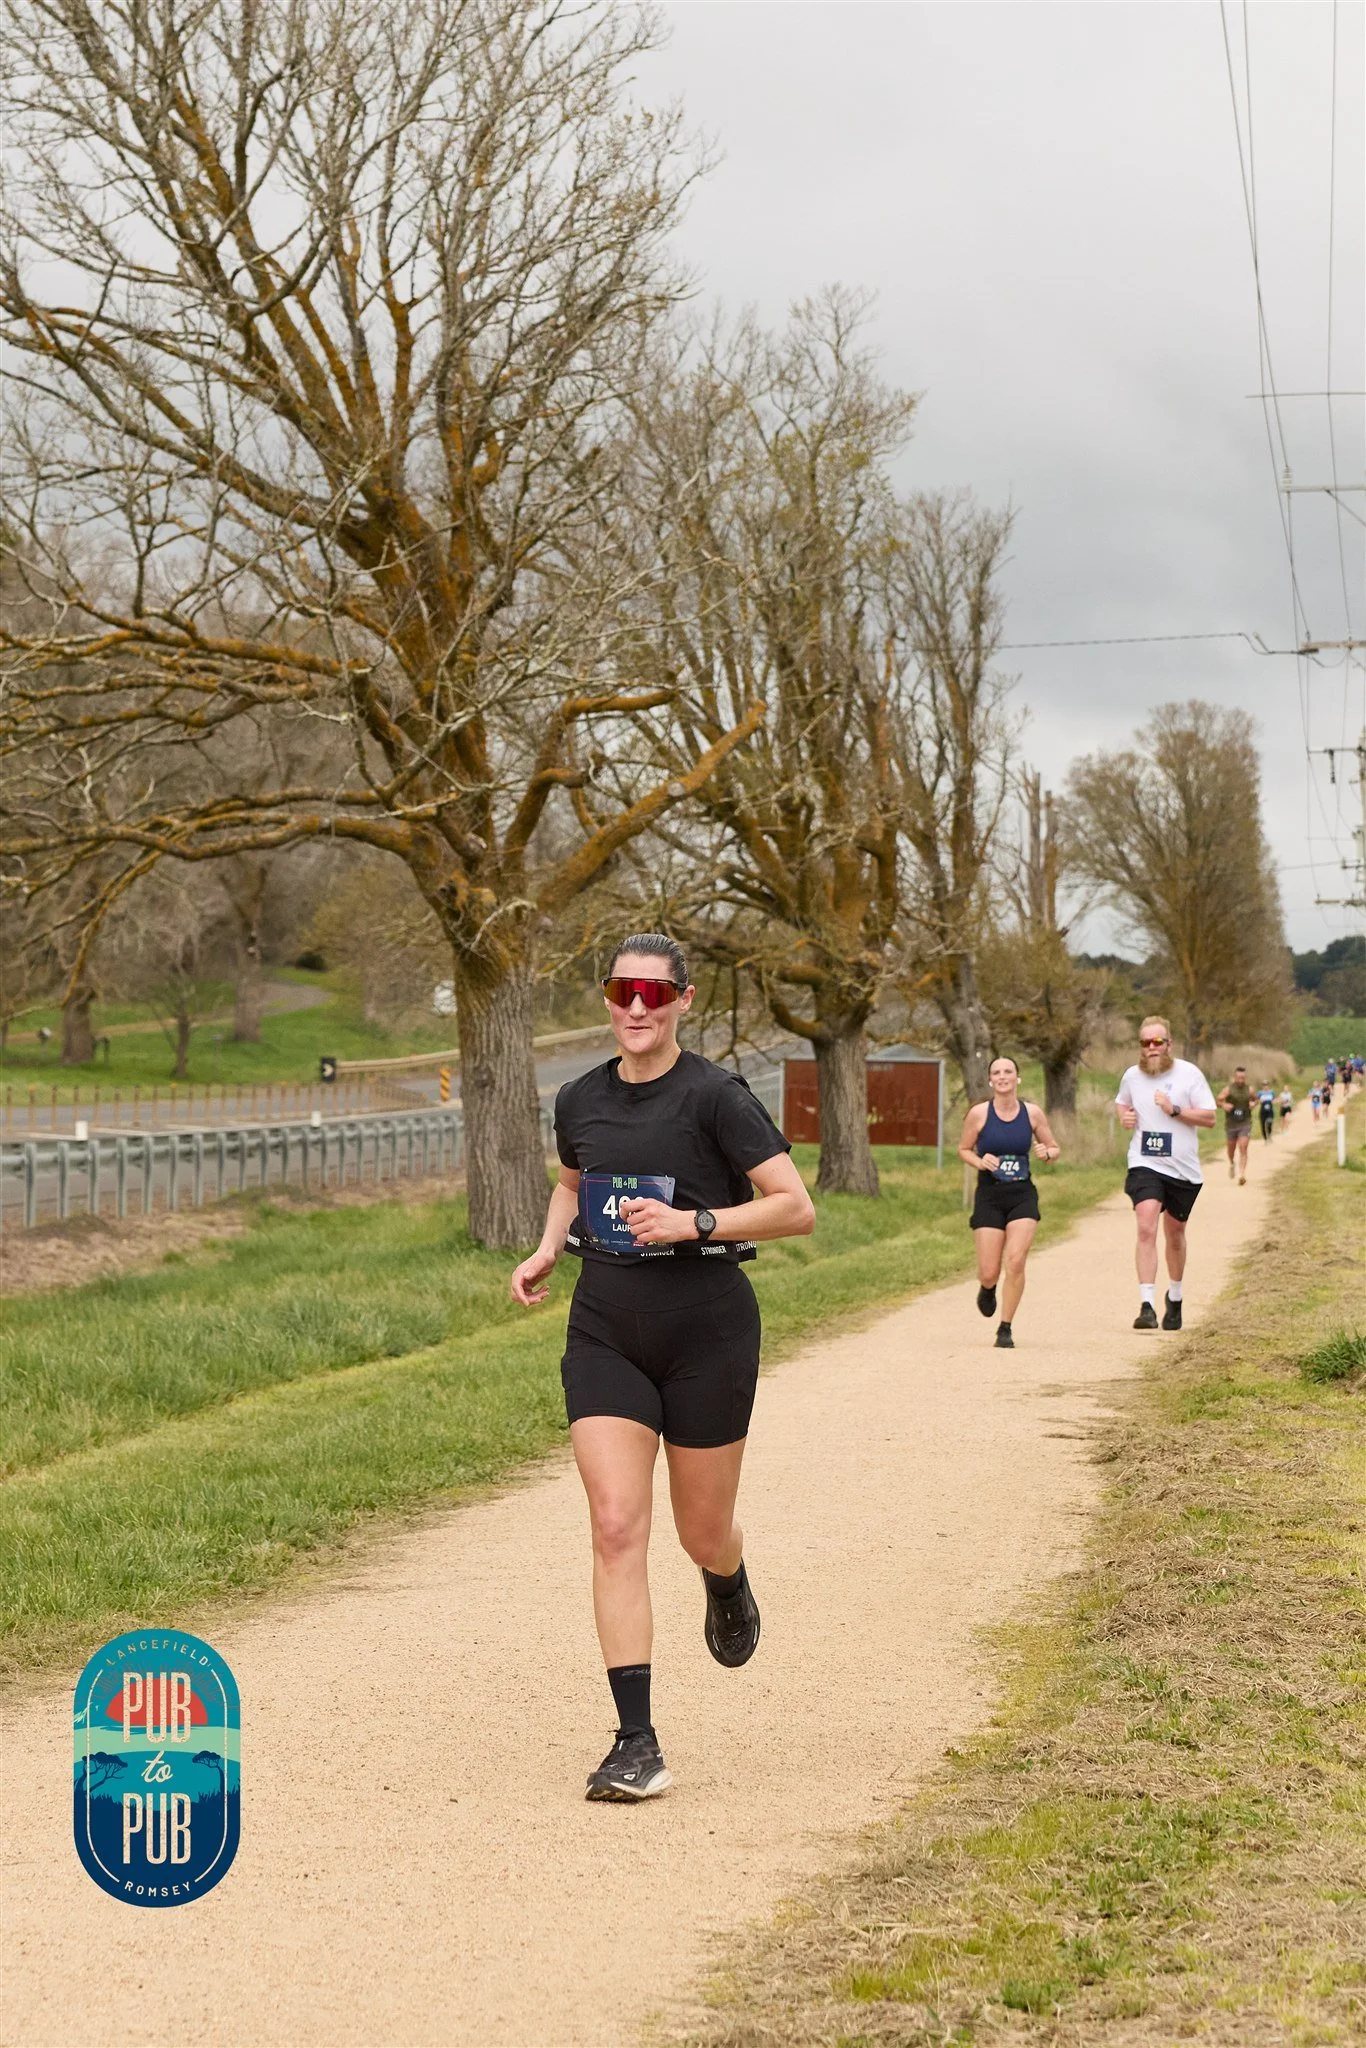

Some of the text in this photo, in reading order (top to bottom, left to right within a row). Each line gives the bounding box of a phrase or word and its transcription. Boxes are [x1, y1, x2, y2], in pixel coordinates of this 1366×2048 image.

[1146, 1137, 1164, 1148] 418
[1000, 1161, 1020, 1171] 474
[612, 1177, 622, 1188] PUB
[628, 1178, 638, 1189] PUB
